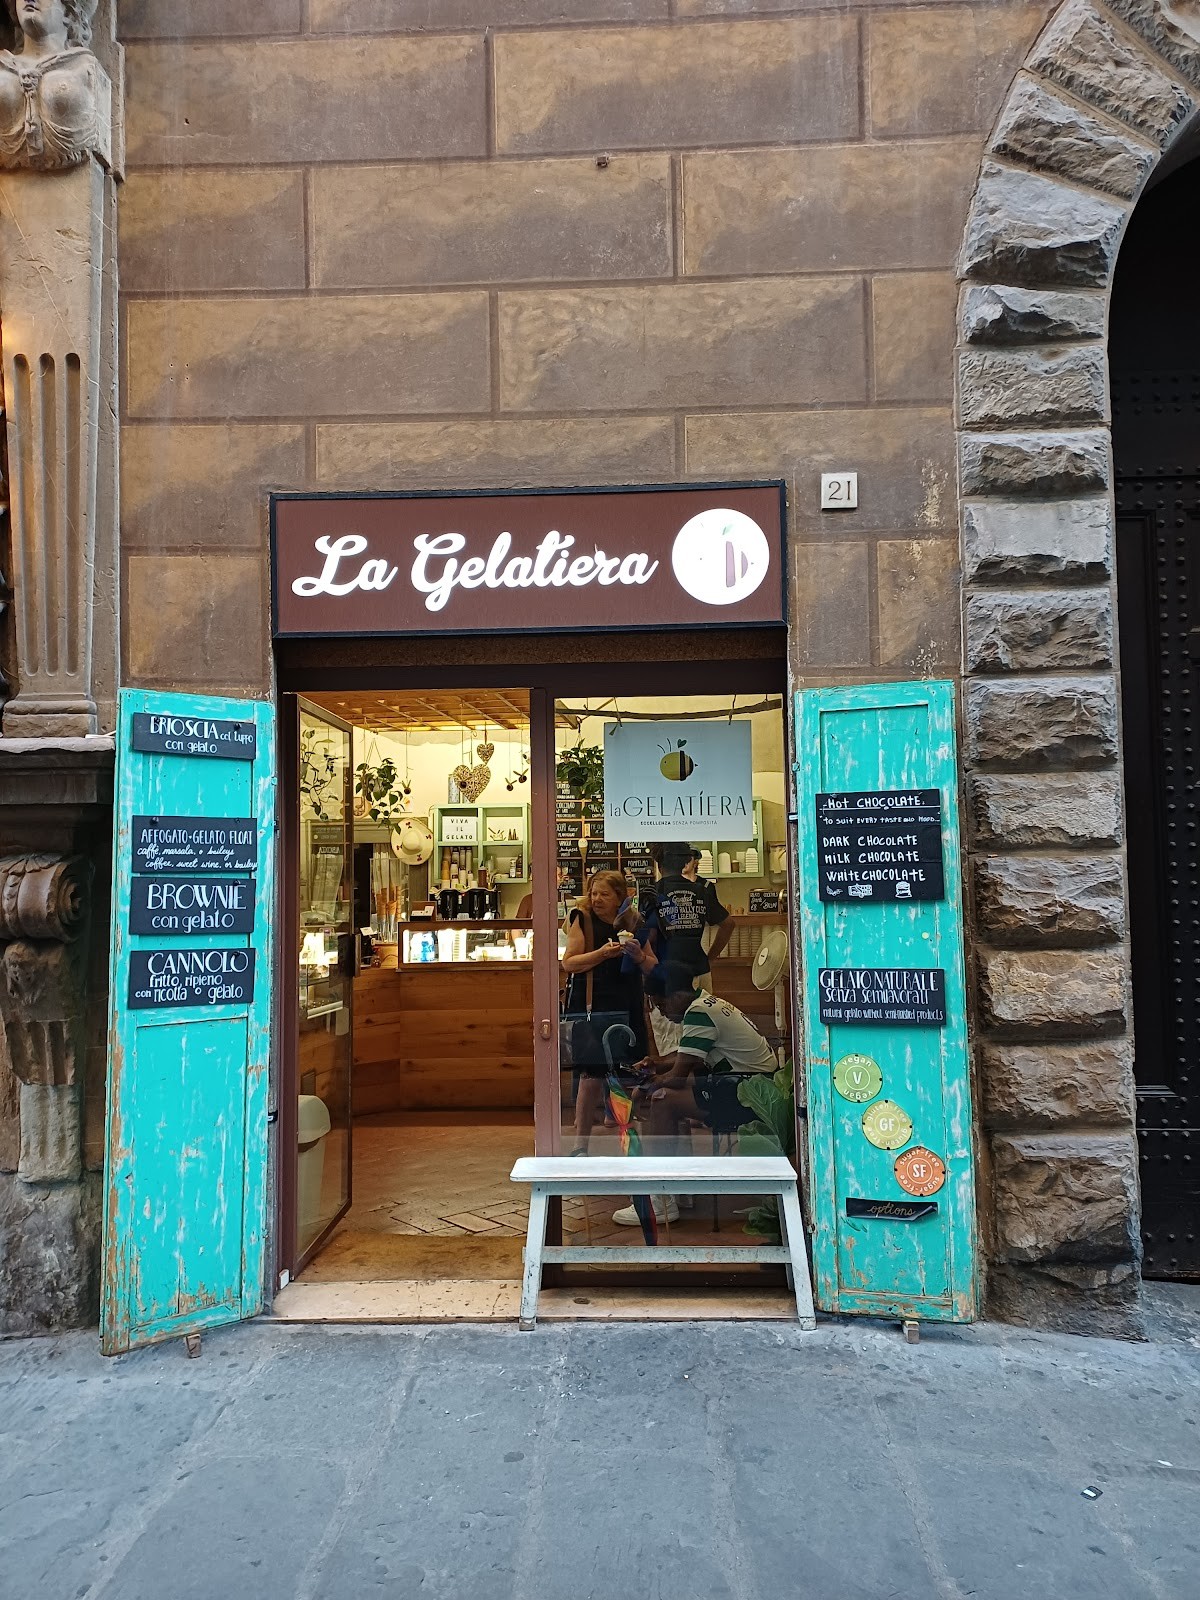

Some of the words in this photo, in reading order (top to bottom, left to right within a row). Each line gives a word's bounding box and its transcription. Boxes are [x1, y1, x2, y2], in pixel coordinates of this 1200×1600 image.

[828, 480, 851, 501] 21
[292, 534, 397, 597] La
[411, 530, 659, 612] Gelatiera
[150, 715, 219, 740] BRIOSCIA
[165, 739, 184, 751] con
[187, 740, 218, 754] gelato
[229, 830, 253, 845] FLOAT
[823, 836, 850, 847] DARK
[857, 834, 918, 847] CHOCOLATE
[176, 858, 198, 868] sweet
[858, 851, 919, 863] CHOCOLATE
[861, 868, 926, 881] CHOCOLATE
[146, 883, 247, 910] BROWNIE
[151, 914, 179, 929] con
[182, 910, 235, 934] gelato
[147, 950, 249, 975] CANNOLO
[185, 974, 223, 989] ripieno
[820, 969, 872, 990] GELATO
[874, 970, 939, 991] NATURALE
[135, 990, 152, 998] con
[153, 987, 188, 1003] ricotta
[194, 987, 202, 995] o
[207, 984, 243, 1004] gelato
[825, 987, 857, 1003] senza
[823, 1007, 842, 1018] natural
[844, 1007, 862, 1023] gelato
[862, 1008, 883, 1019] without
[916, 1008, 944, 1023] products
[841, 1056, 872, 1067] vegan
[852, 1071, 863, 1085] V
[843, 1089, 874, 1100] vegan
[879, 1117, 895, 1132] GF
[900, 1149, 940, 1167] sugar-free
[912, 1163, 927, 1178] SF
[900, 1174, 940, 1192] sugar-free
[867, 1203, 915, 1217] options
